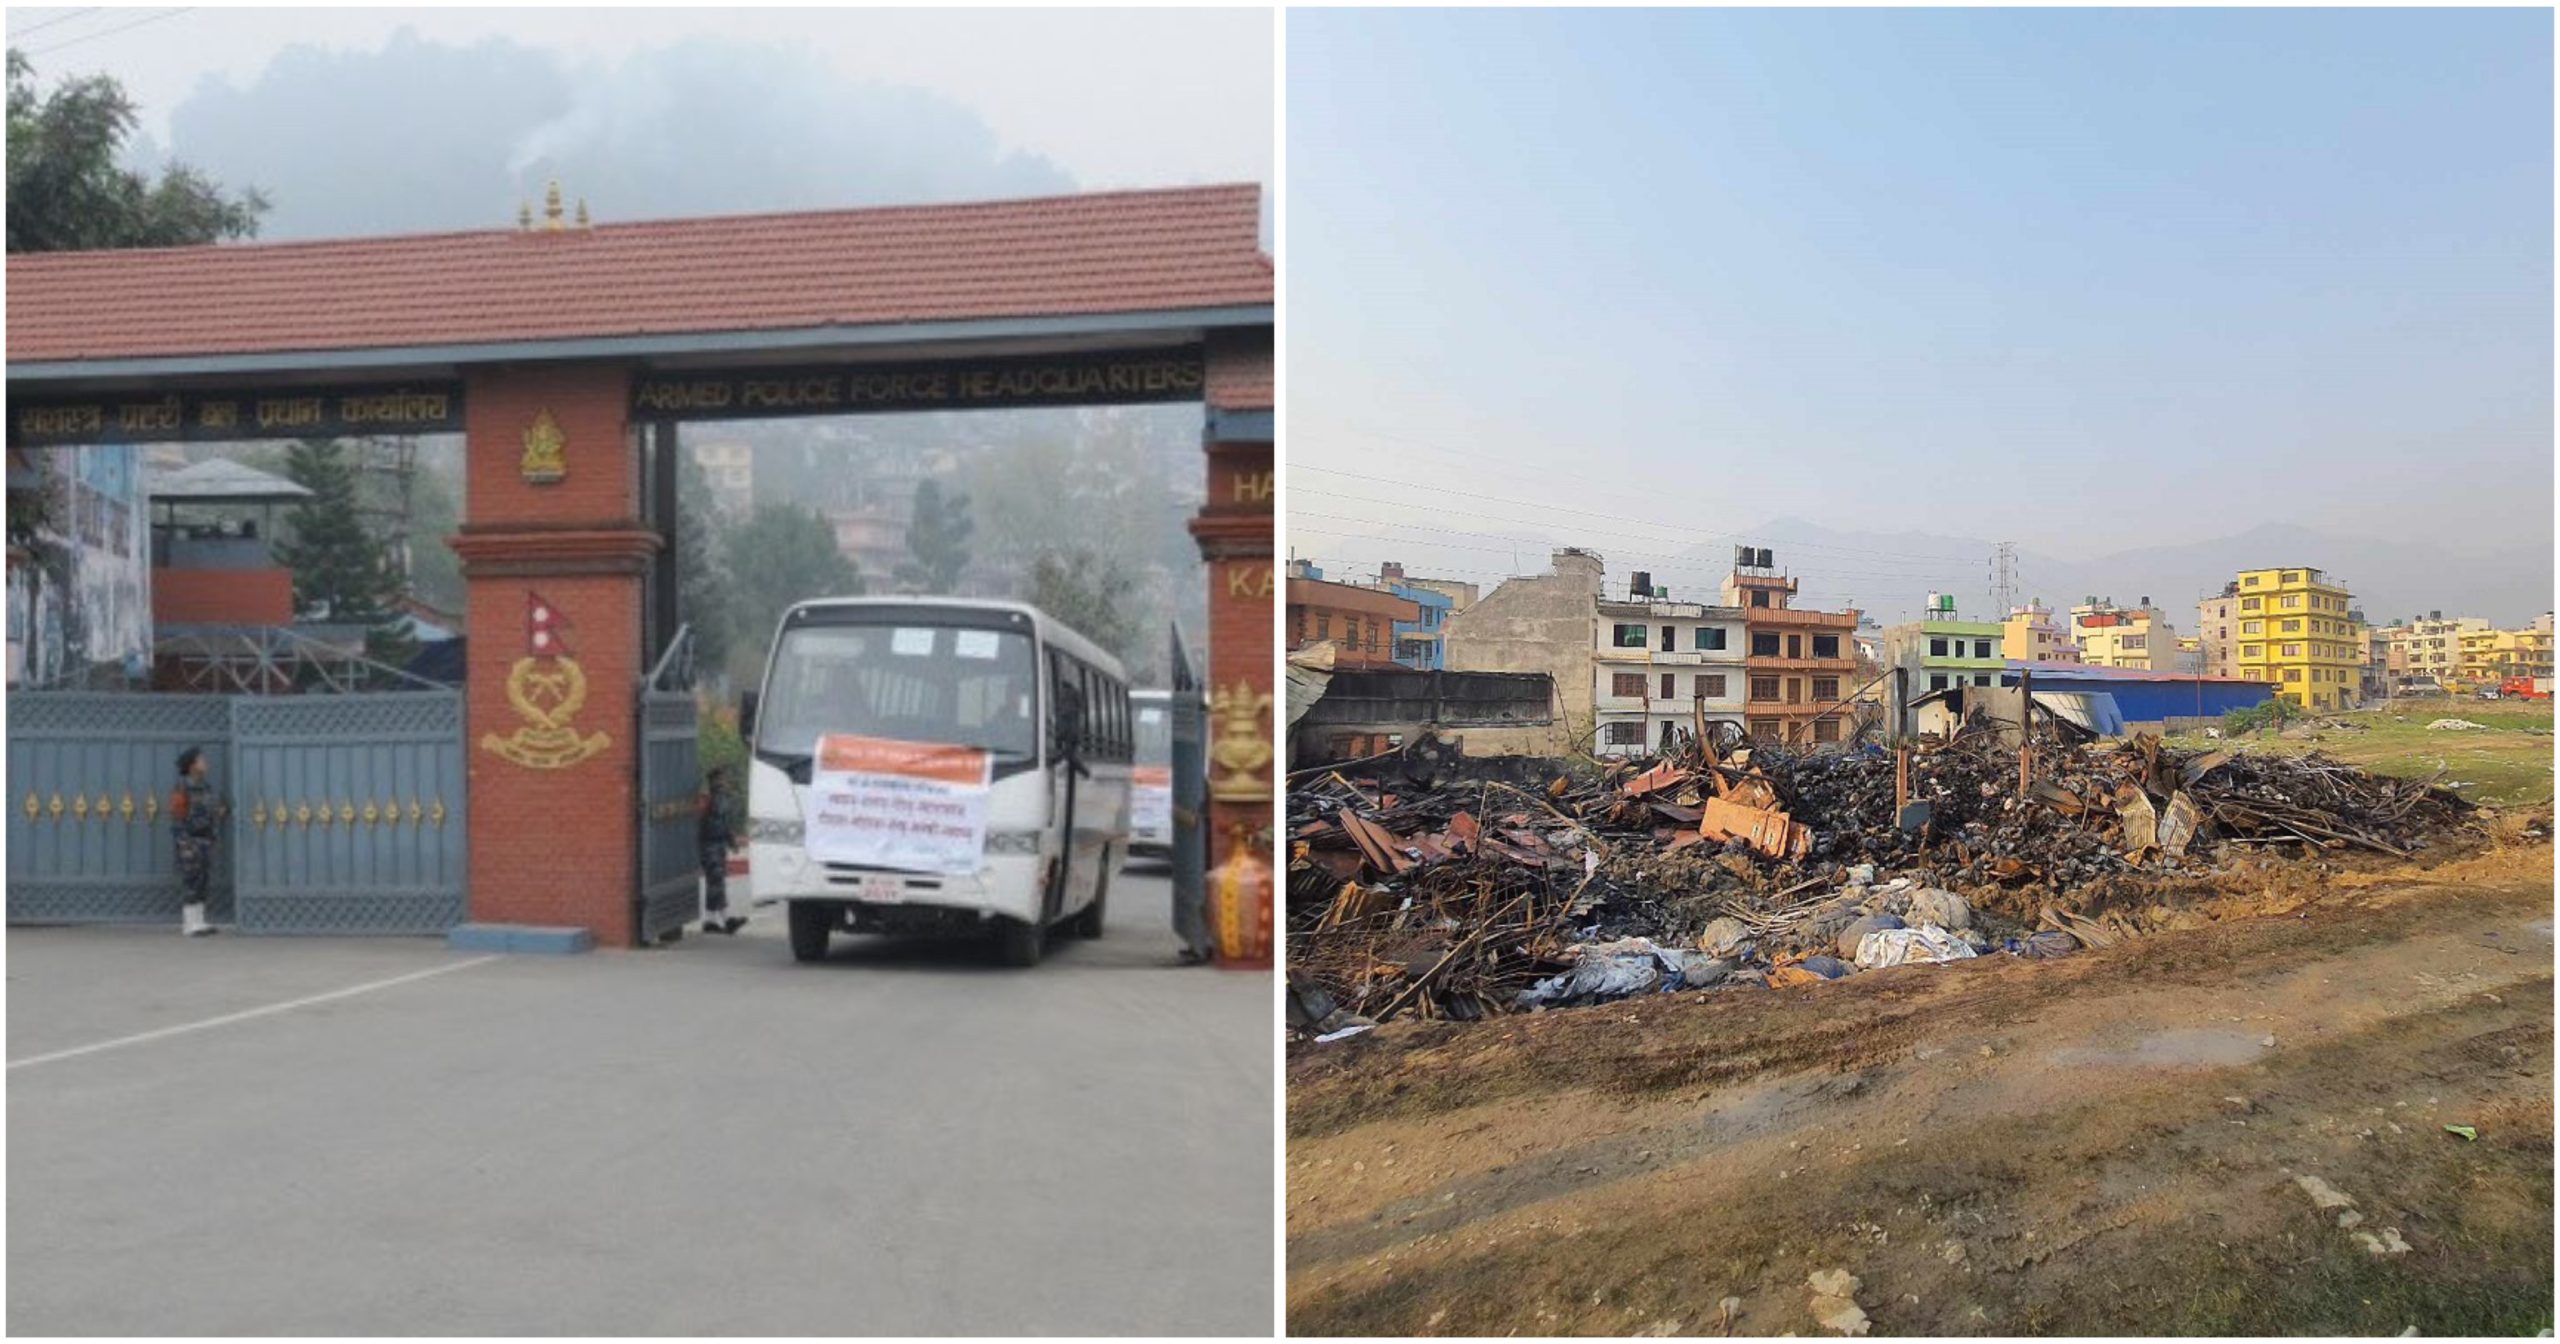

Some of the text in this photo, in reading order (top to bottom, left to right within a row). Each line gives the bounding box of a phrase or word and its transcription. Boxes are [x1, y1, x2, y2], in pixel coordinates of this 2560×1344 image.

[639, 361, 1203, 409] ARMED POLICE FORCE HEADQUARTERS
